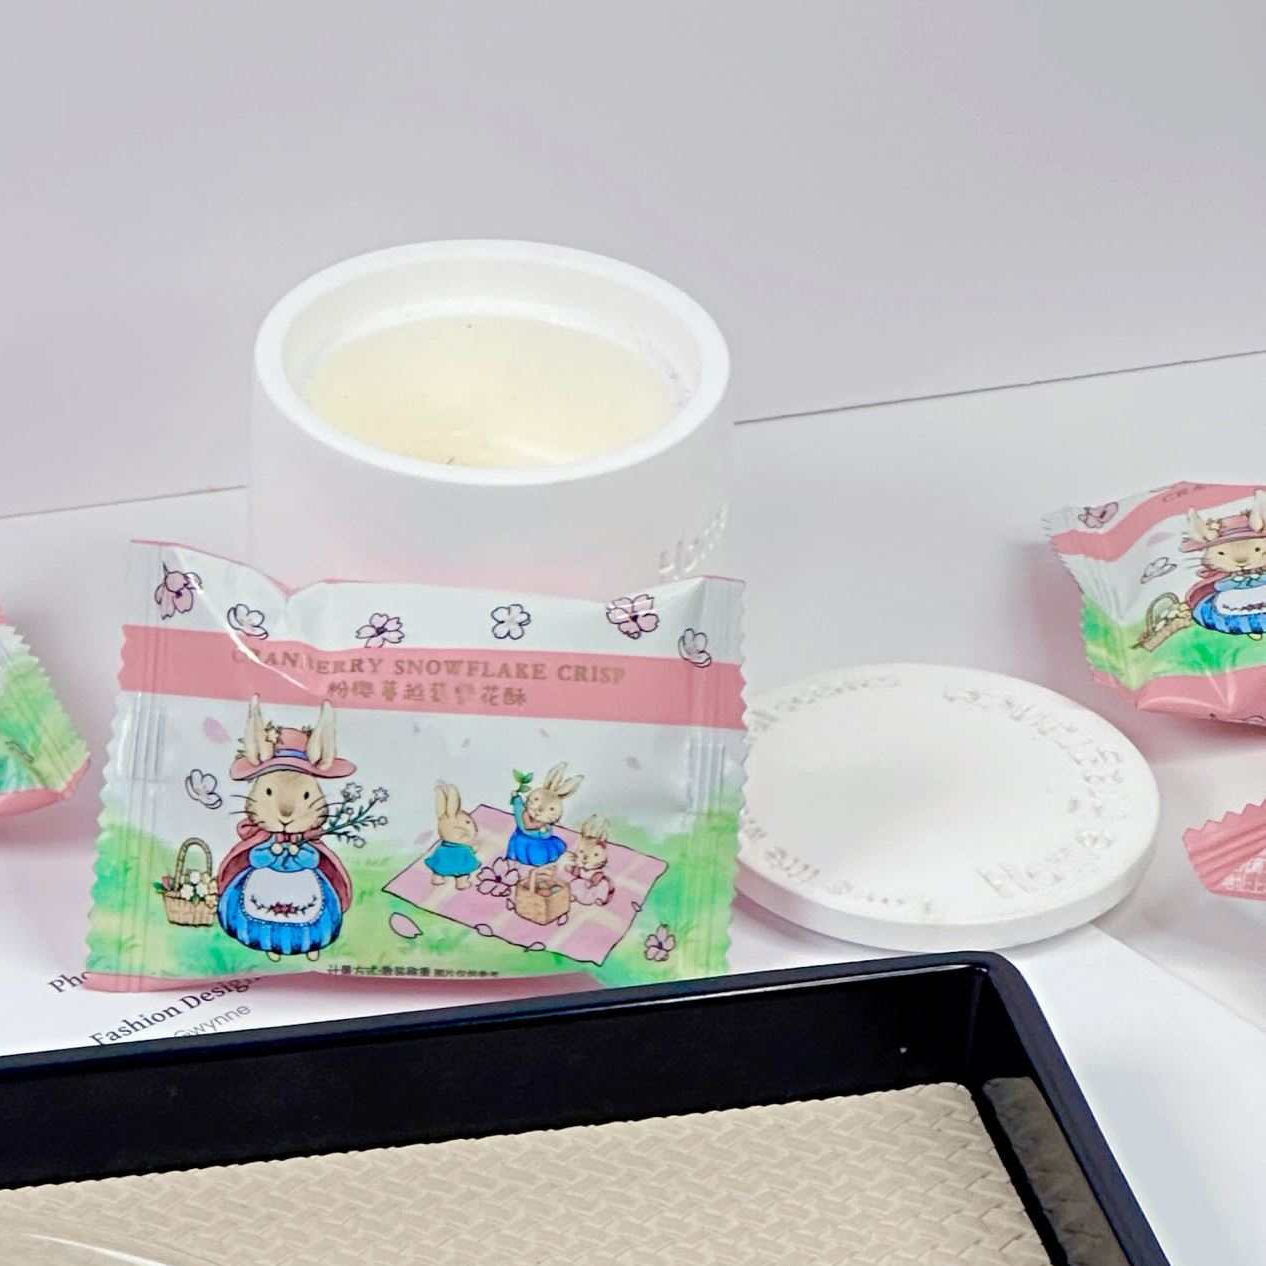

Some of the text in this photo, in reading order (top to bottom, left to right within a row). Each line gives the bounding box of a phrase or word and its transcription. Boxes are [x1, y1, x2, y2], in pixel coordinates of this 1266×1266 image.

[394, 658, 547, 681] SNOWFLAKE
[557, 663, 626, 685] CRISP
[90, 1004, 182, 1046] Fashion
